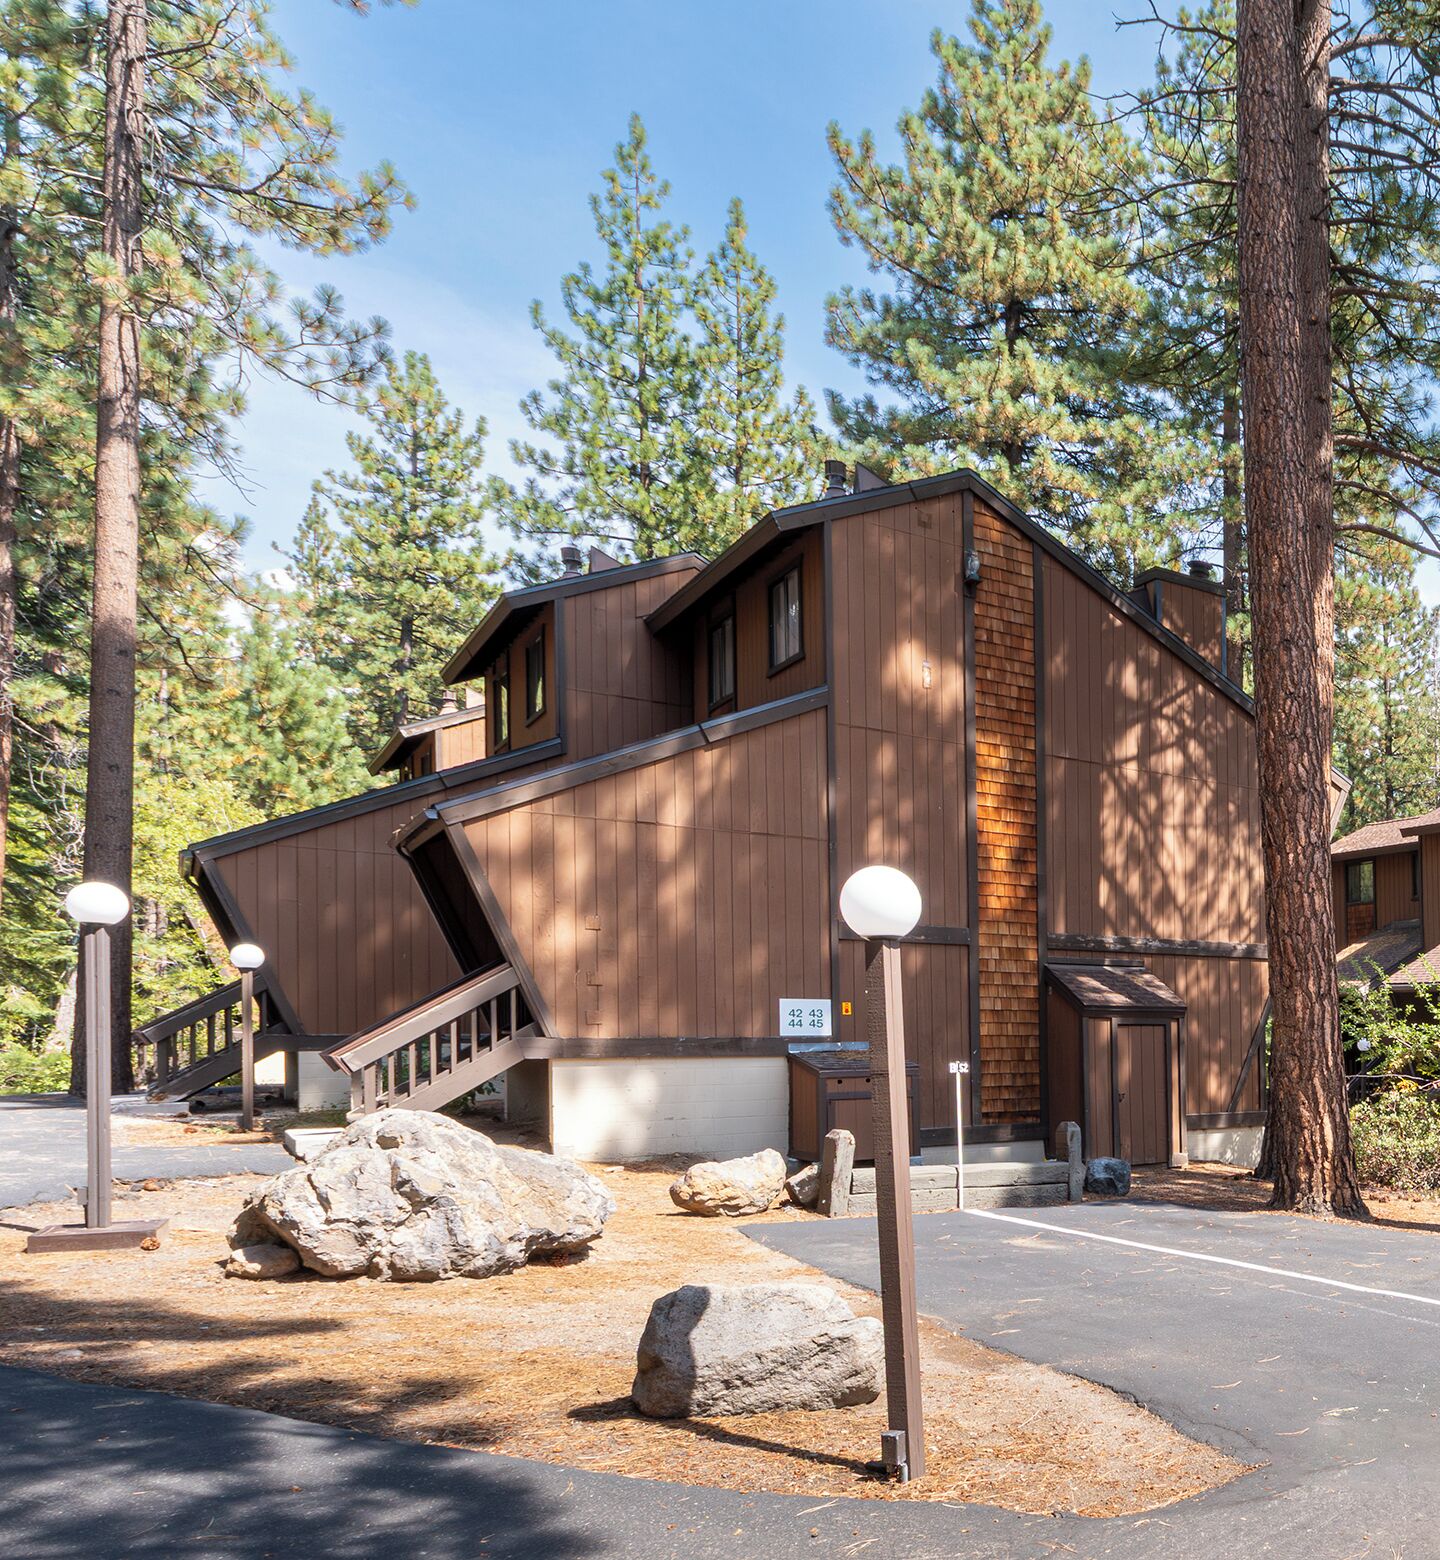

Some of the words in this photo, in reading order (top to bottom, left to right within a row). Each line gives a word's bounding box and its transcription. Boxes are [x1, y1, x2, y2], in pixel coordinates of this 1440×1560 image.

[788, 1009, 803, 1017] 42
[809, 1009, 823, 1018] 43
[788, 1019, 803, 1027] 44
[809, 1019, 823, 1028] 45
